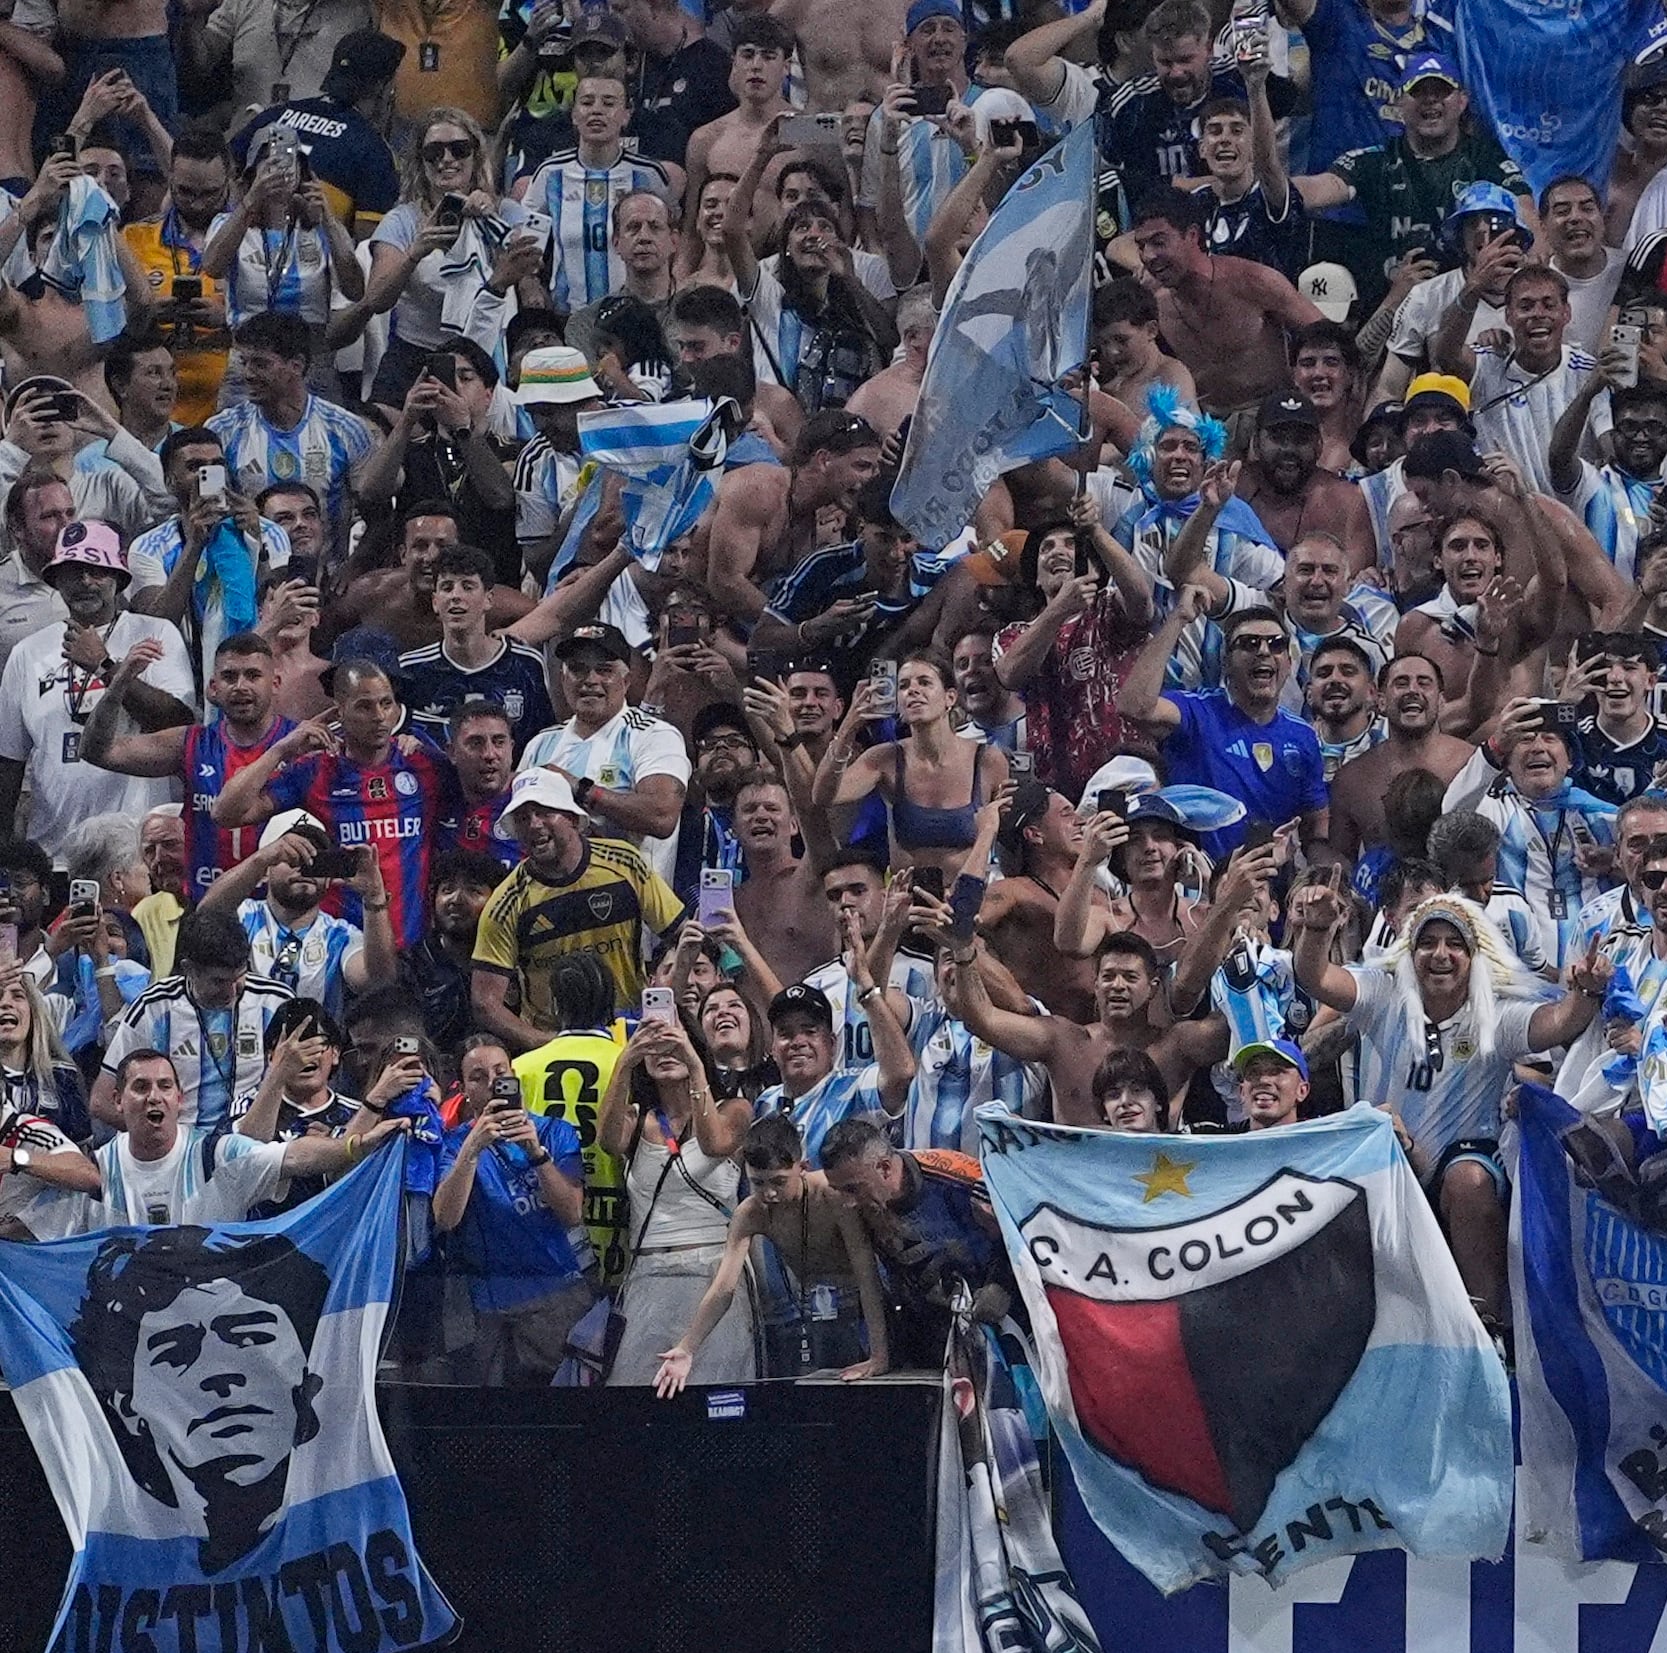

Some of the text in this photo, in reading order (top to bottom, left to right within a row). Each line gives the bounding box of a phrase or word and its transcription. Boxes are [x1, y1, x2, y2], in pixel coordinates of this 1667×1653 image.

[275, 107, 347, 139] PAREDES
[340, 817, 421, 844] BUTTELER
[1085, 1251, 1130, 1287] A.
[1148, 1189, 1316, 1281] COLON
